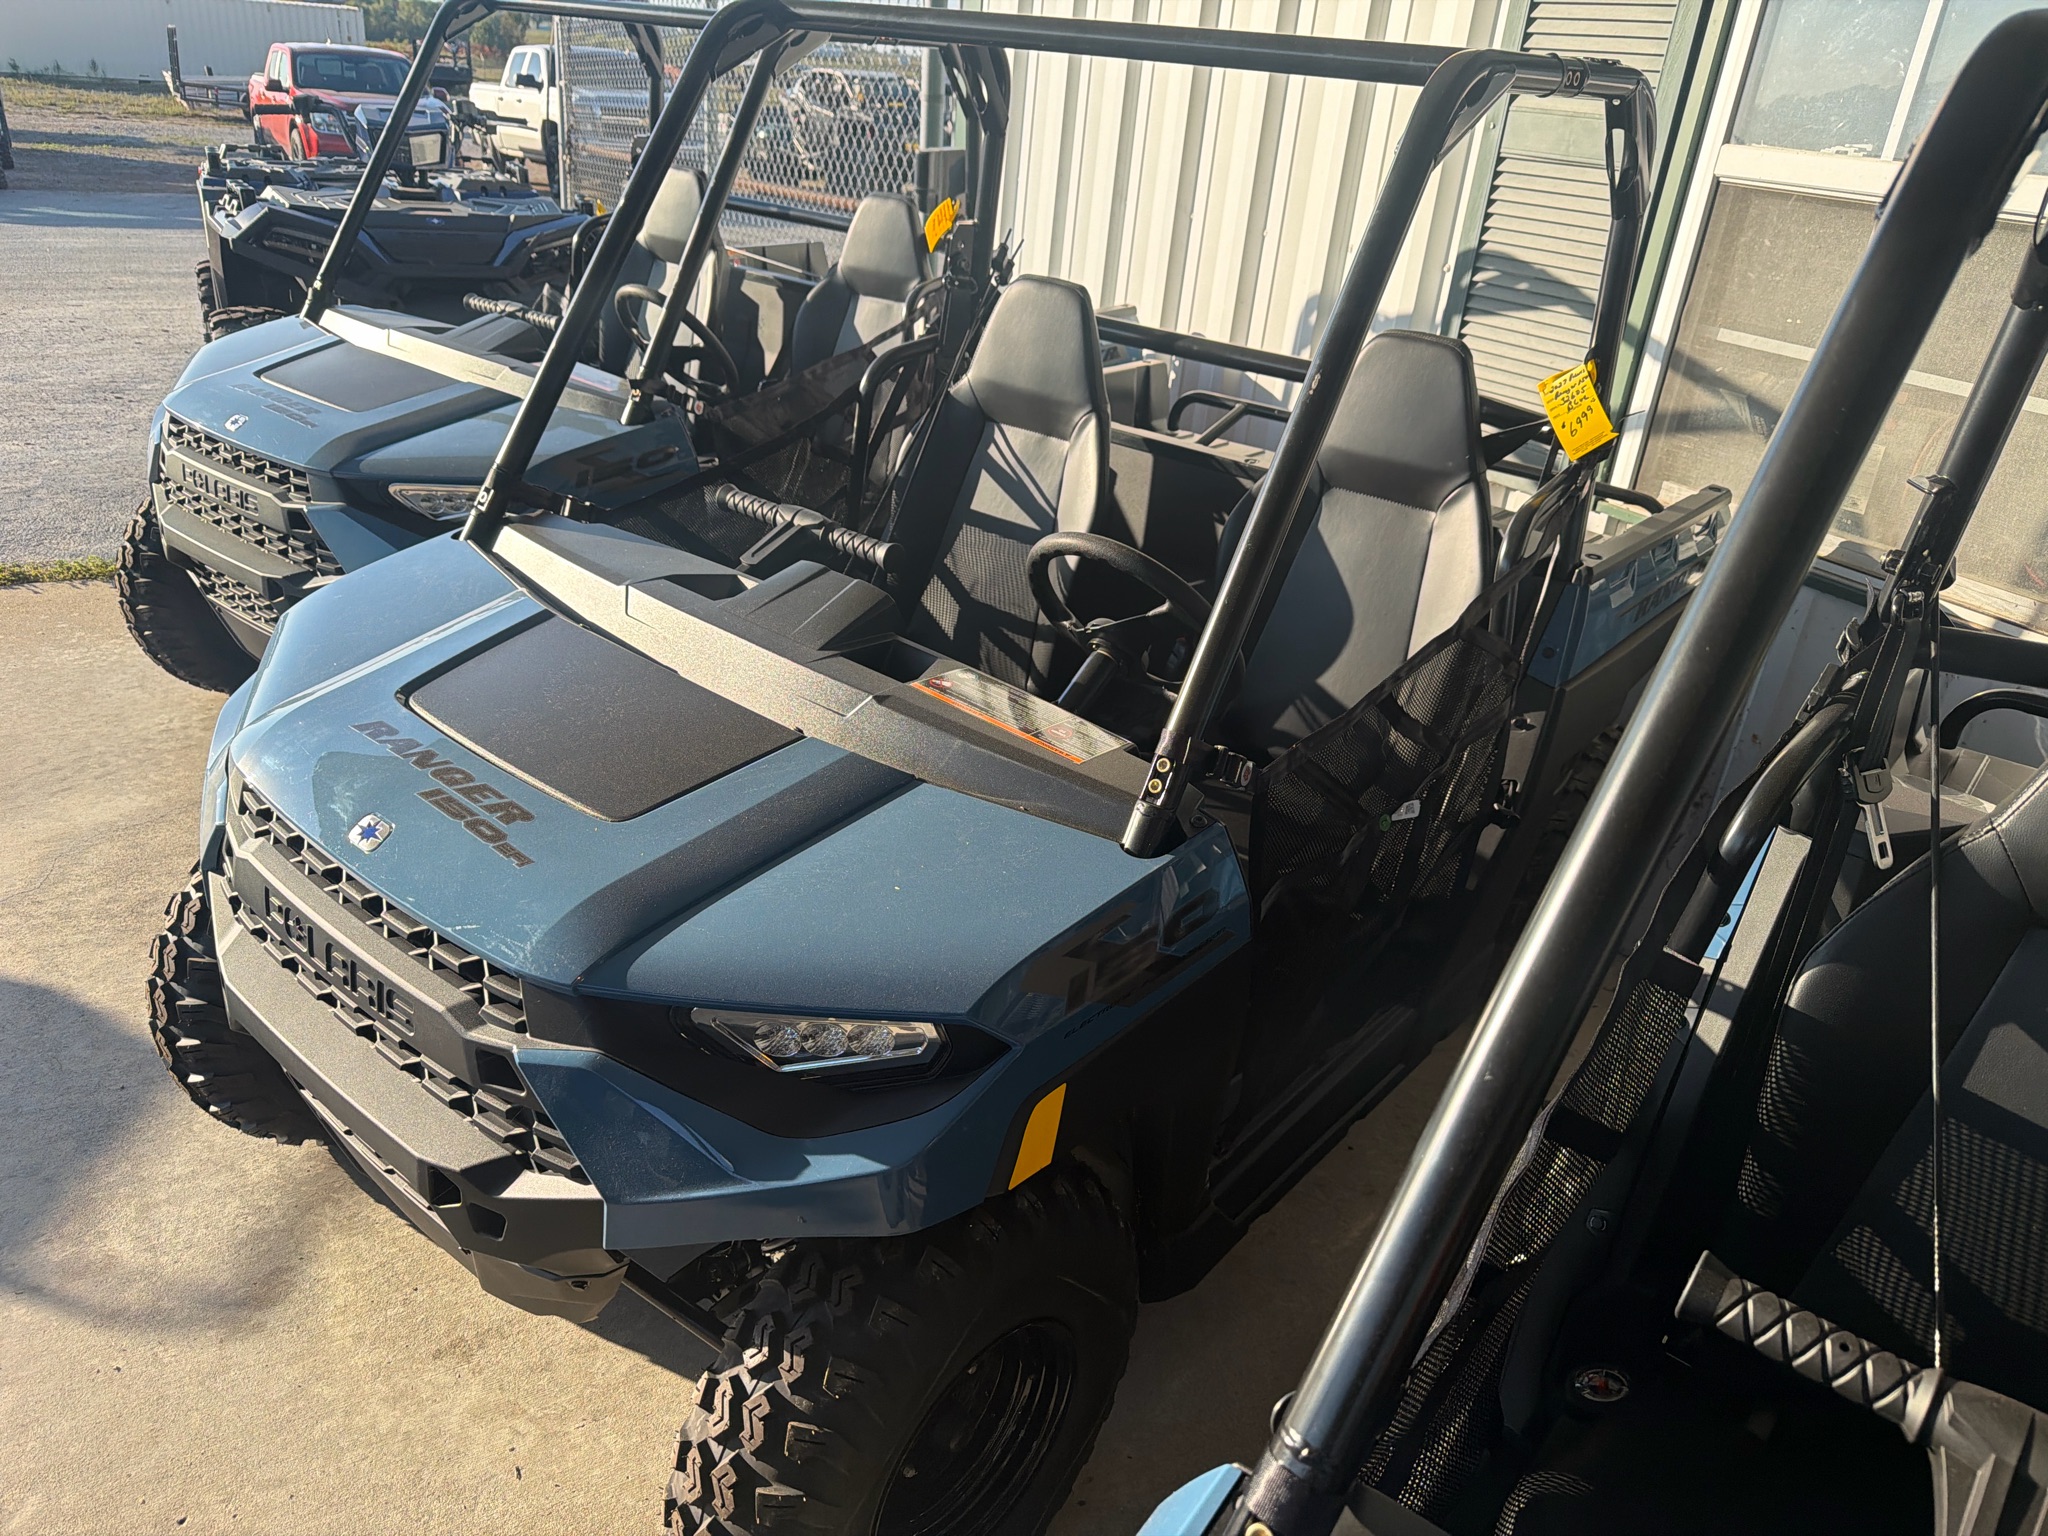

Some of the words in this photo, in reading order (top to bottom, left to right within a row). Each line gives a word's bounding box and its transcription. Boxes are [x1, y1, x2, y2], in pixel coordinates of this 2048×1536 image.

[181, 463, 260, 516] POLARIS
[349, 719, 537, 826] RANGER
[415, 787, 508, 847] 150
[264, 885, 416, 1037] POLARIS
